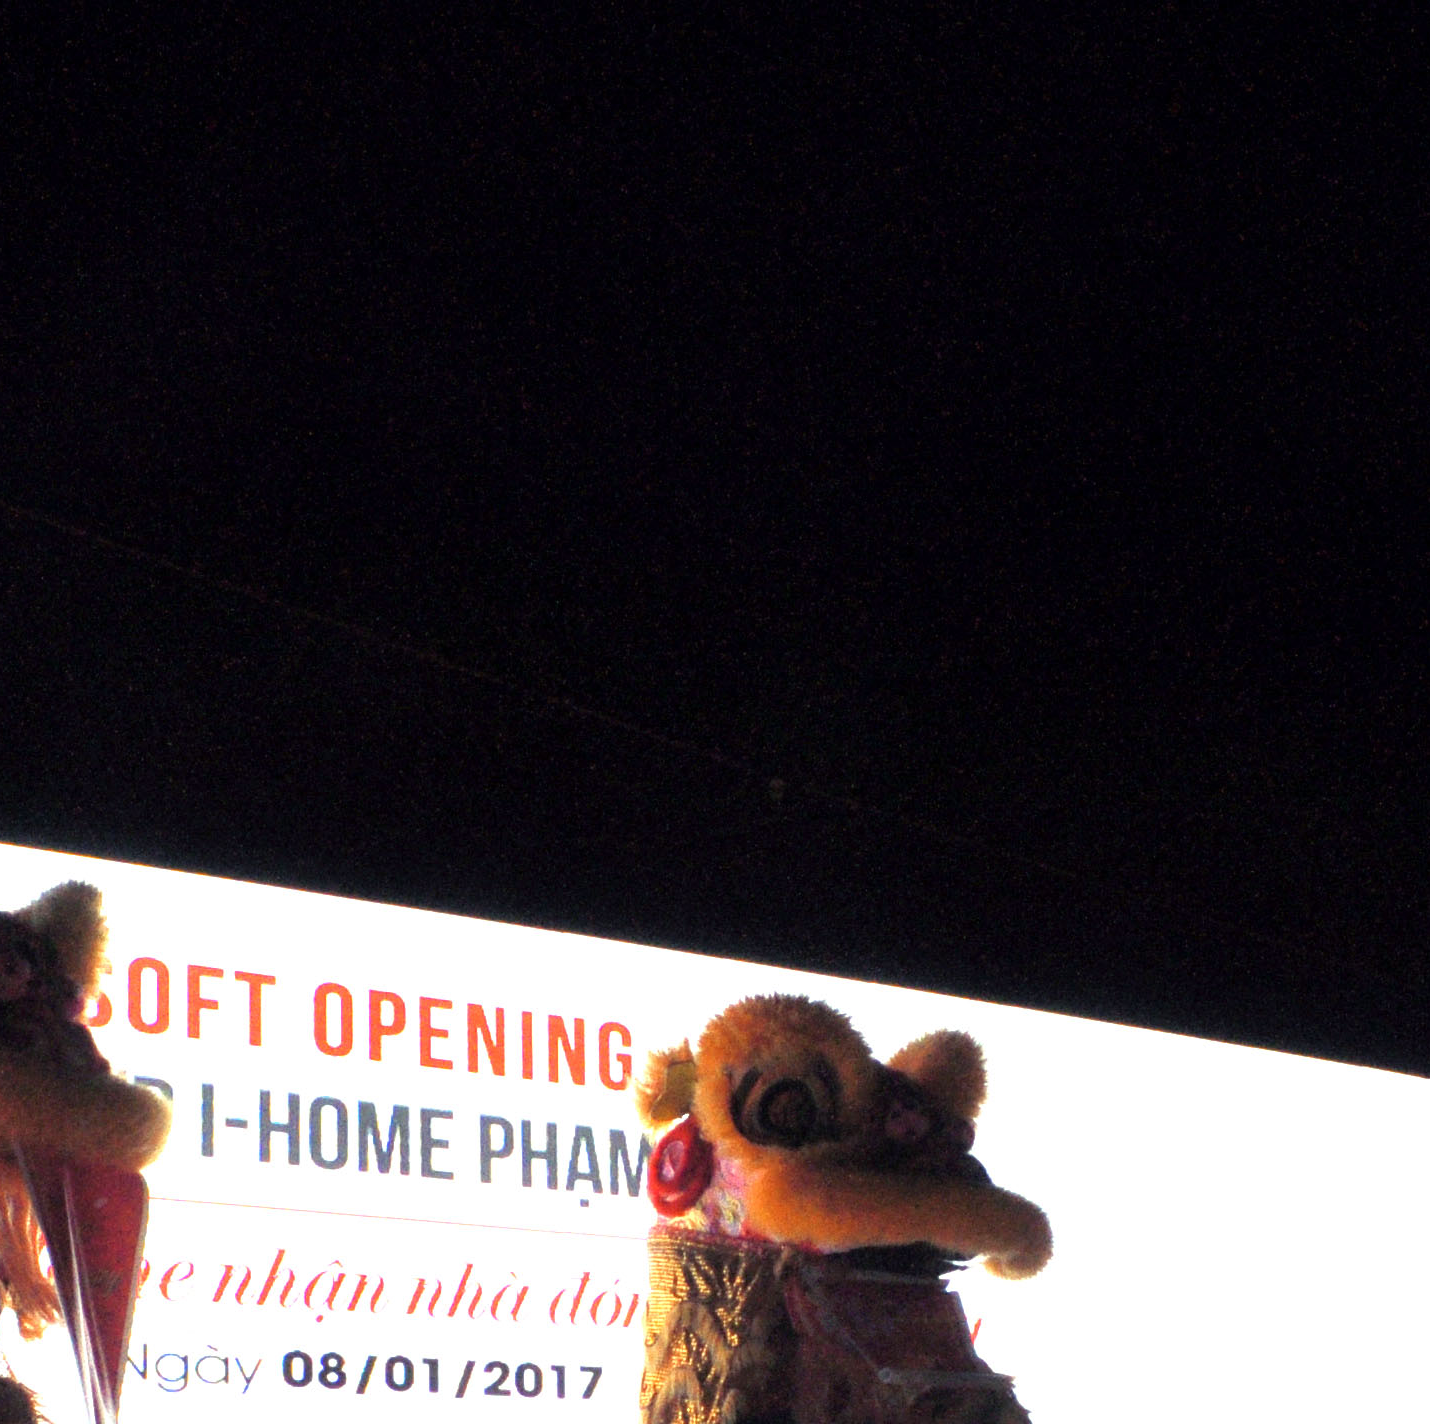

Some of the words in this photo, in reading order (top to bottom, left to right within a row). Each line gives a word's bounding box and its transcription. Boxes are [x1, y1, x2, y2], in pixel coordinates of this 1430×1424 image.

[314, 983, 632, 1091] OPENING
[201, 1083, 454, 1180] I-HOME
[480, 1114, 652, 1207] PHẠM
[213, 1248, 389, 1323] nhận
[407, 1264, 529, 1322] nhà
[127, 1343, 262, 1394] Ngày
[282, 1349, 603, 1400] 08/01/2017
